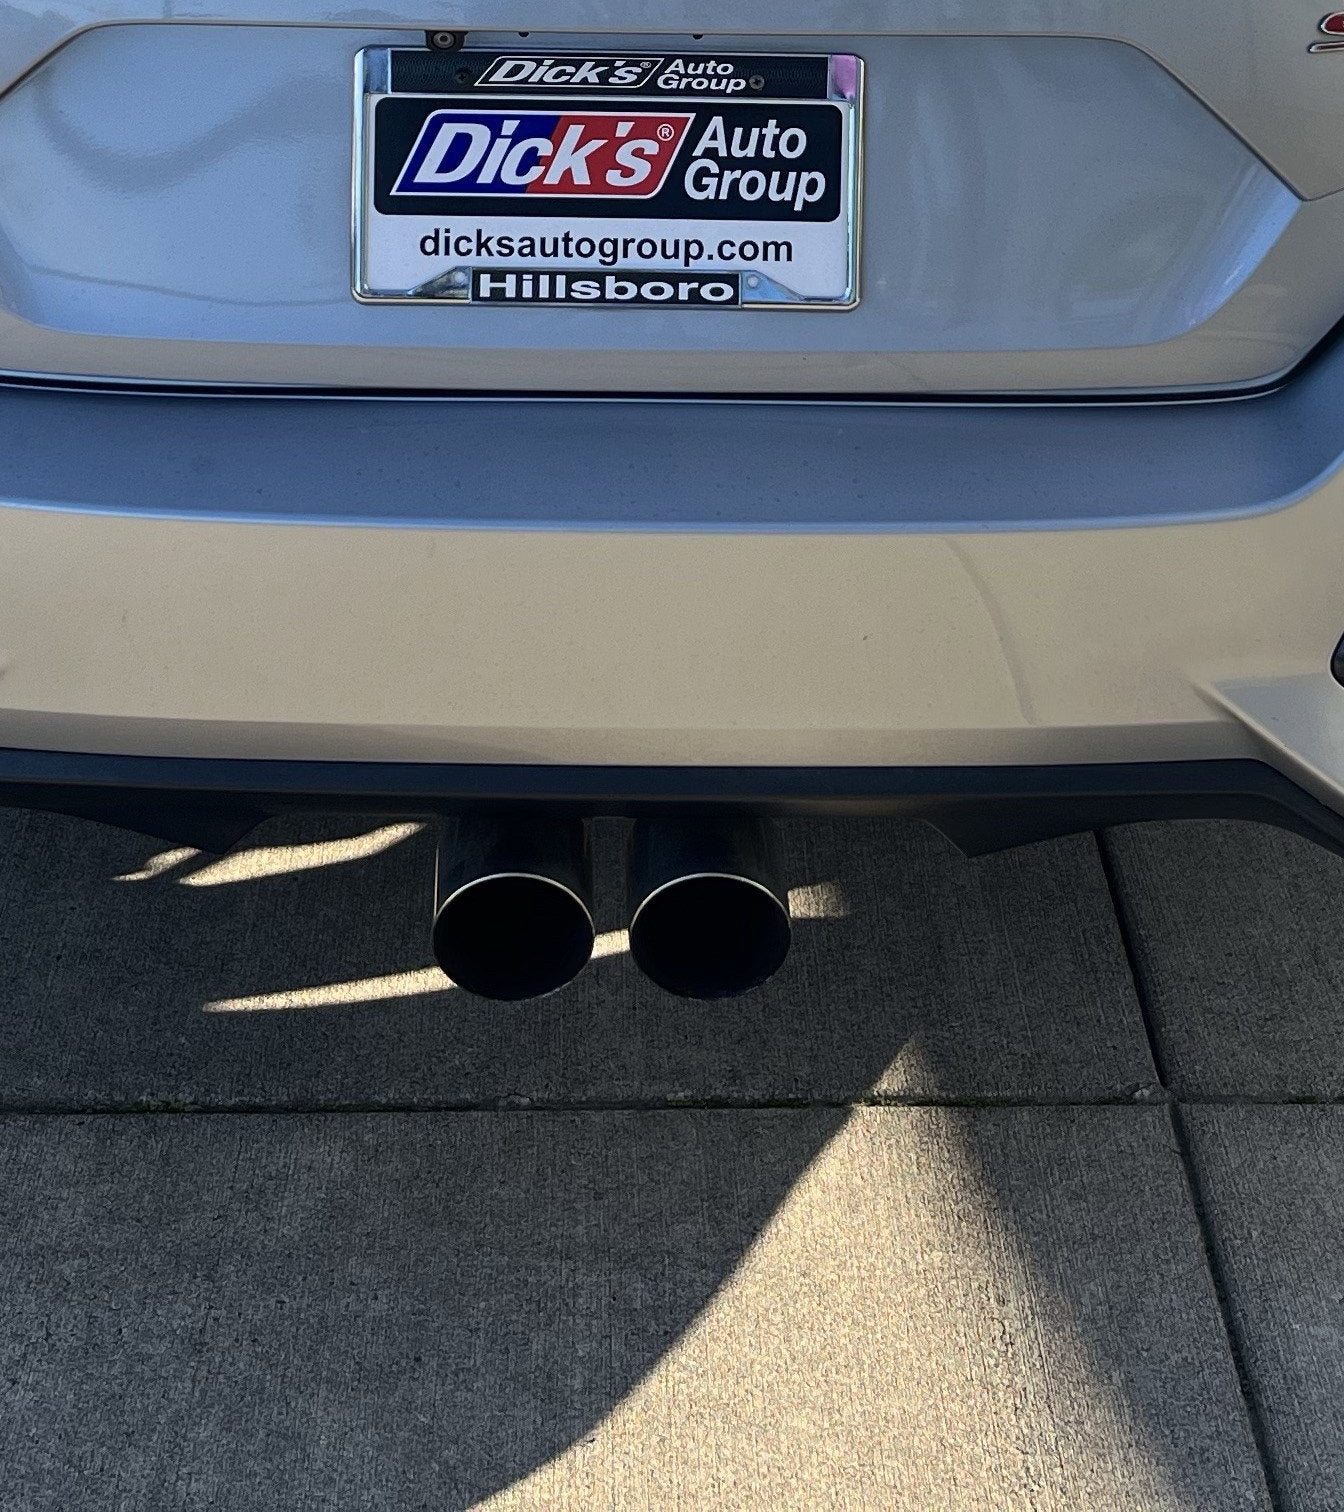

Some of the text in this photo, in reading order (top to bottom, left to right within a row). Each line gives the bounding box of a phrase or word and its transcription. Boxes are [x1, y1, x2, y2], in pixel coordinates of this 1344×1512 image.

[656, 73, 747, 94] Group
[664, 58, 735, 76] Auto
[692, 115, 808, 160] Auto
[683, 158, 826, 212] Group
[419, 228, 794, 267] dicksautogroup.com
[478, 273, 735, 302] Hillsboro
